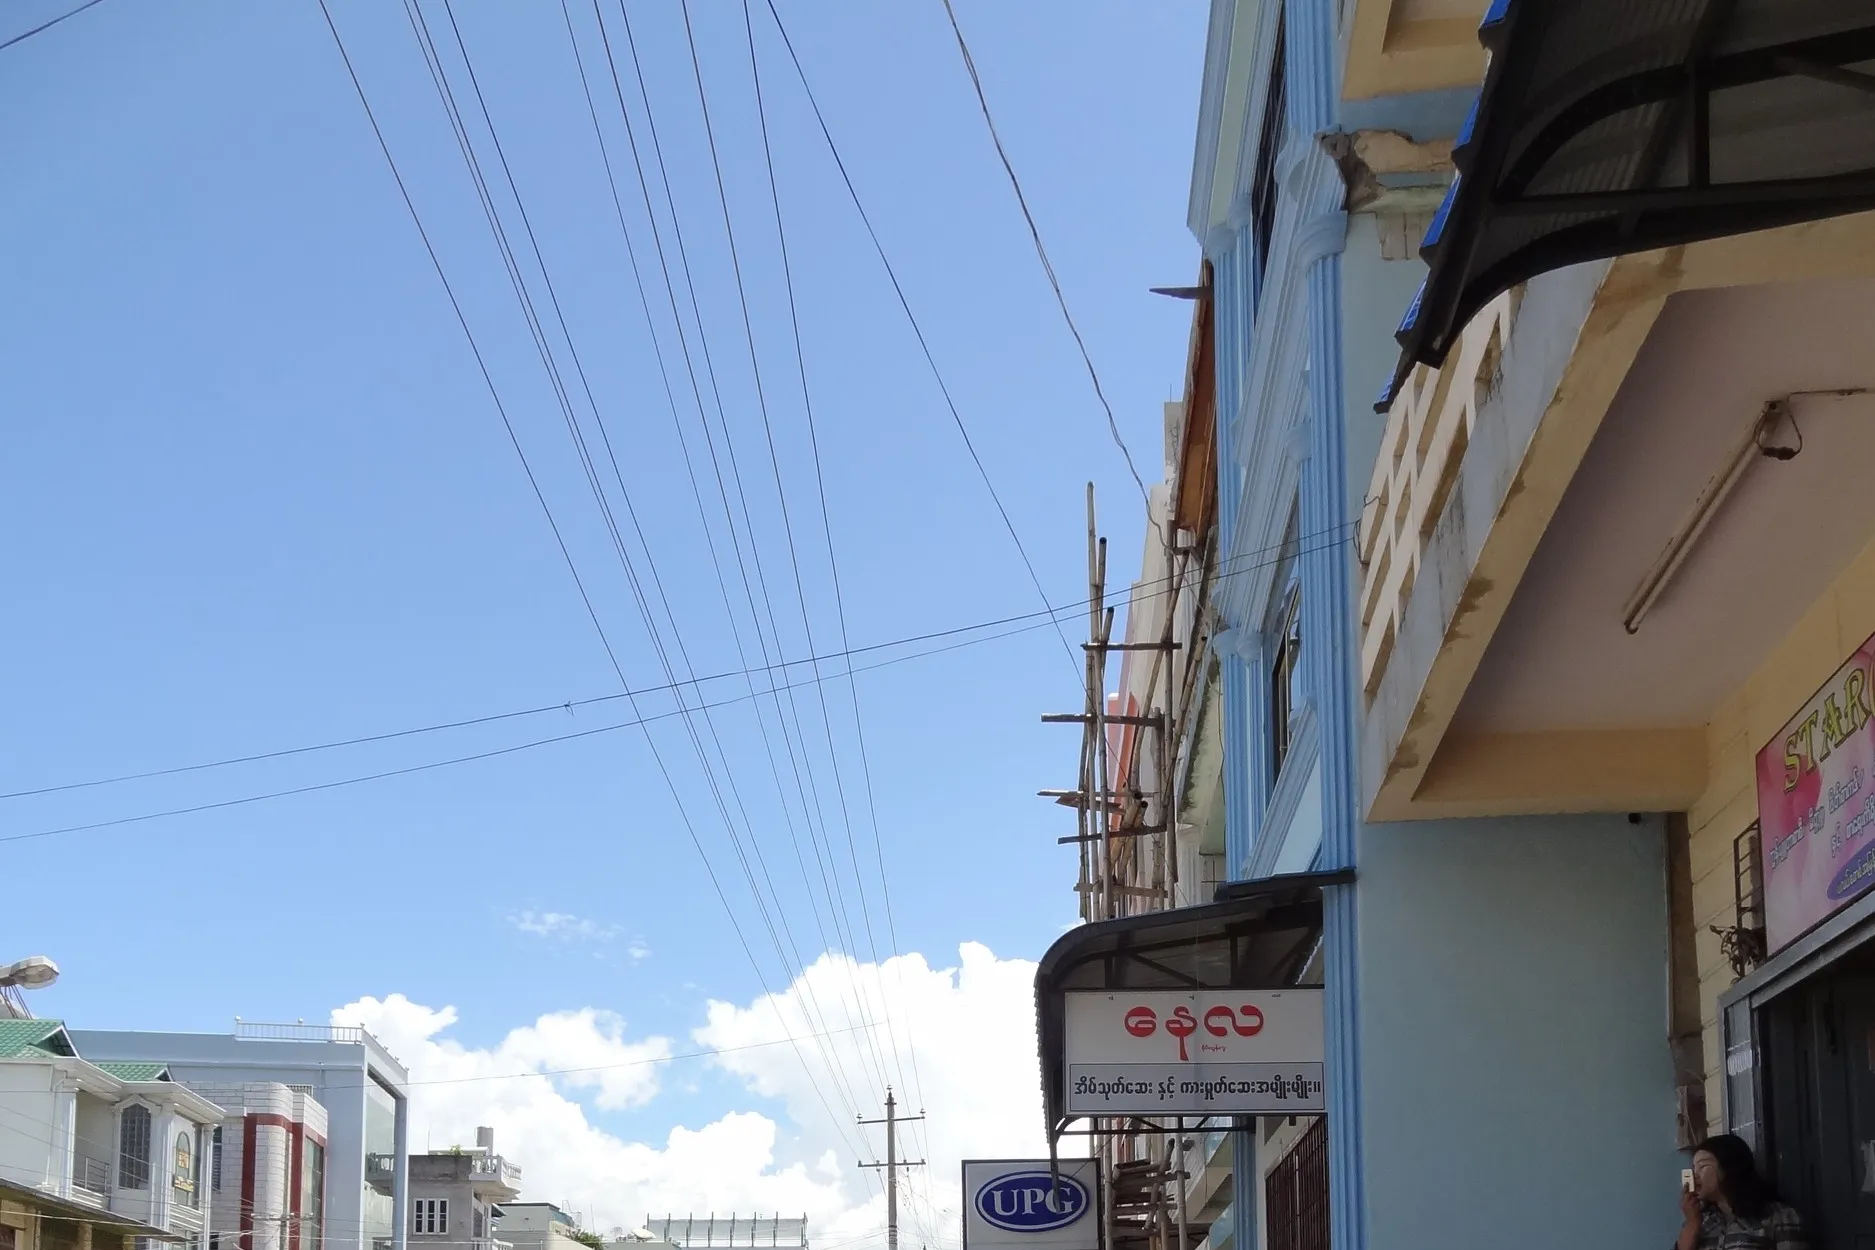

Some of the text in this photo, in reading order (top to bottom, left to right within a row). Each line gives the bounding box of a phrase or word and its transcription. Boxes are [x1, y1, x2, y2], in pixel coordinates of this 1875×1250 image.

[1783, 667, 1871, 794] STAR
[1157, 1075, 1175, 1101] နှင့်
[991, 1187, 1073, 1216] UPG
